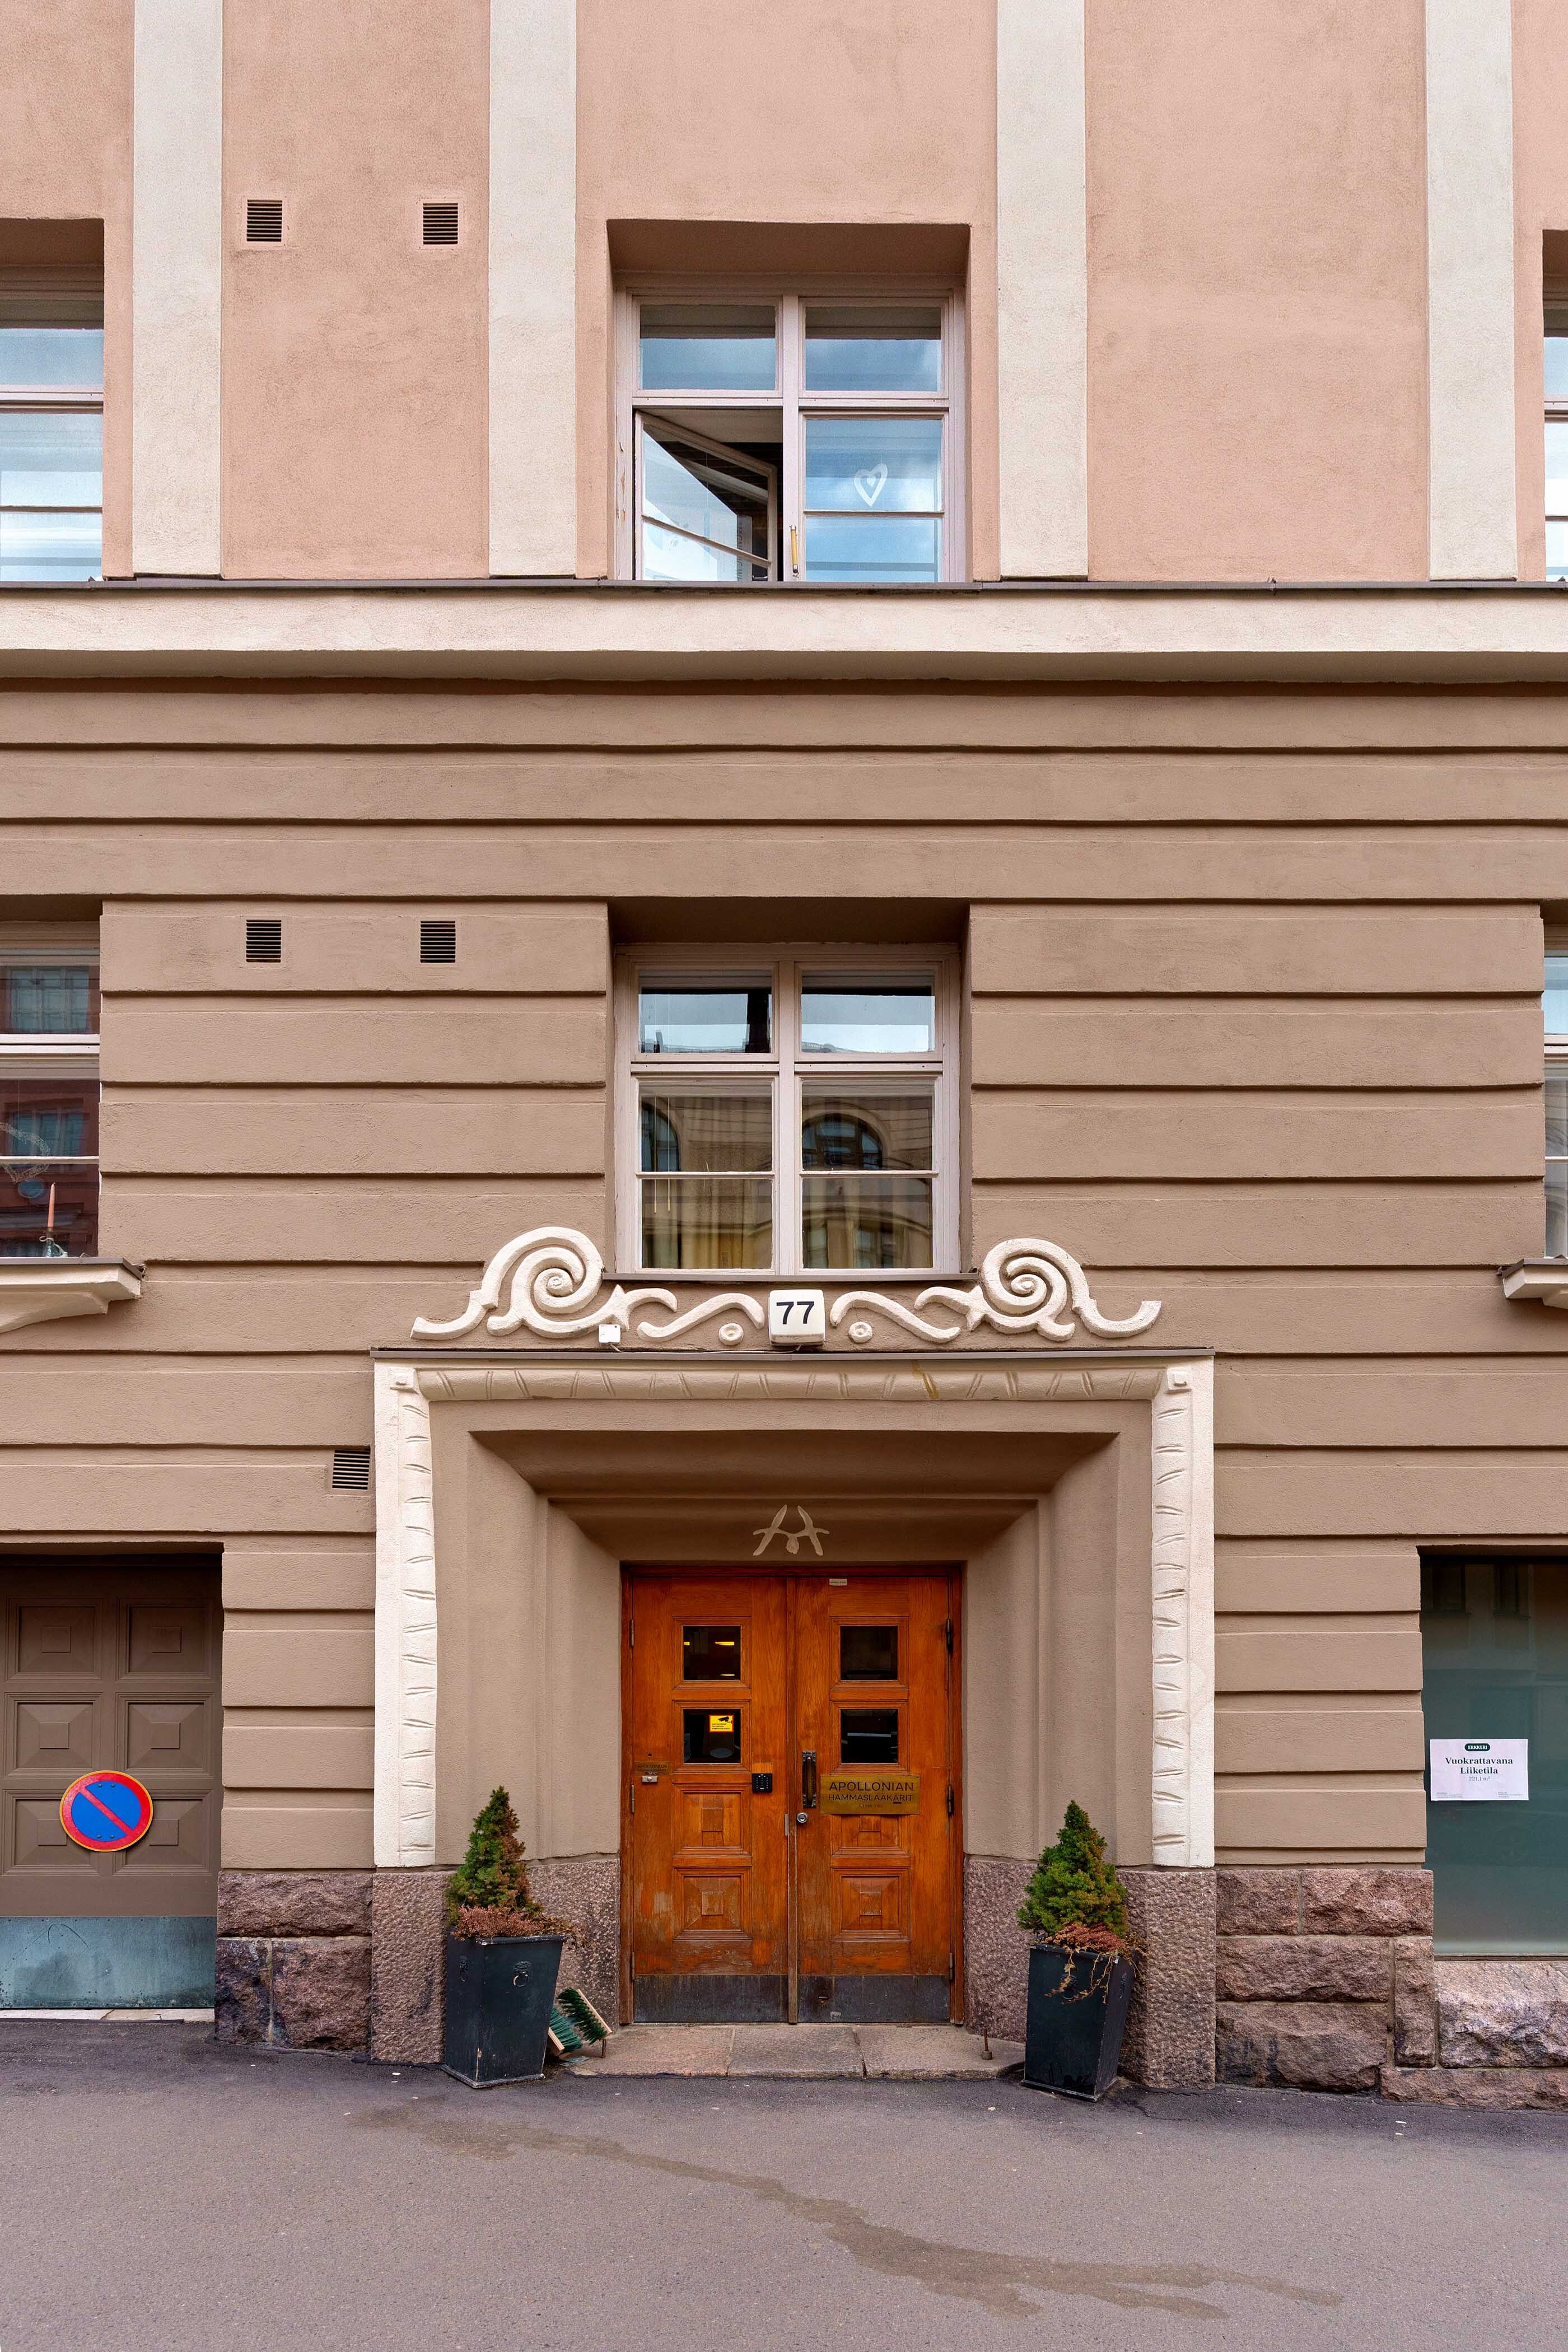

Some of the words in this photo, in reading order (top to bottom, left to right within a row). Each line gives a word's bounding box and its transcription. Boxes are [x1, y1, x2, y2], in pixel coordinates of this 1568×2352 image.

[776, 1301, 814, 1324] 77
[829, 1782, 914, 1791] APOLLONIAN
[829, 1793, 913, 1802] HAMMASLÄÄKÄRIT
